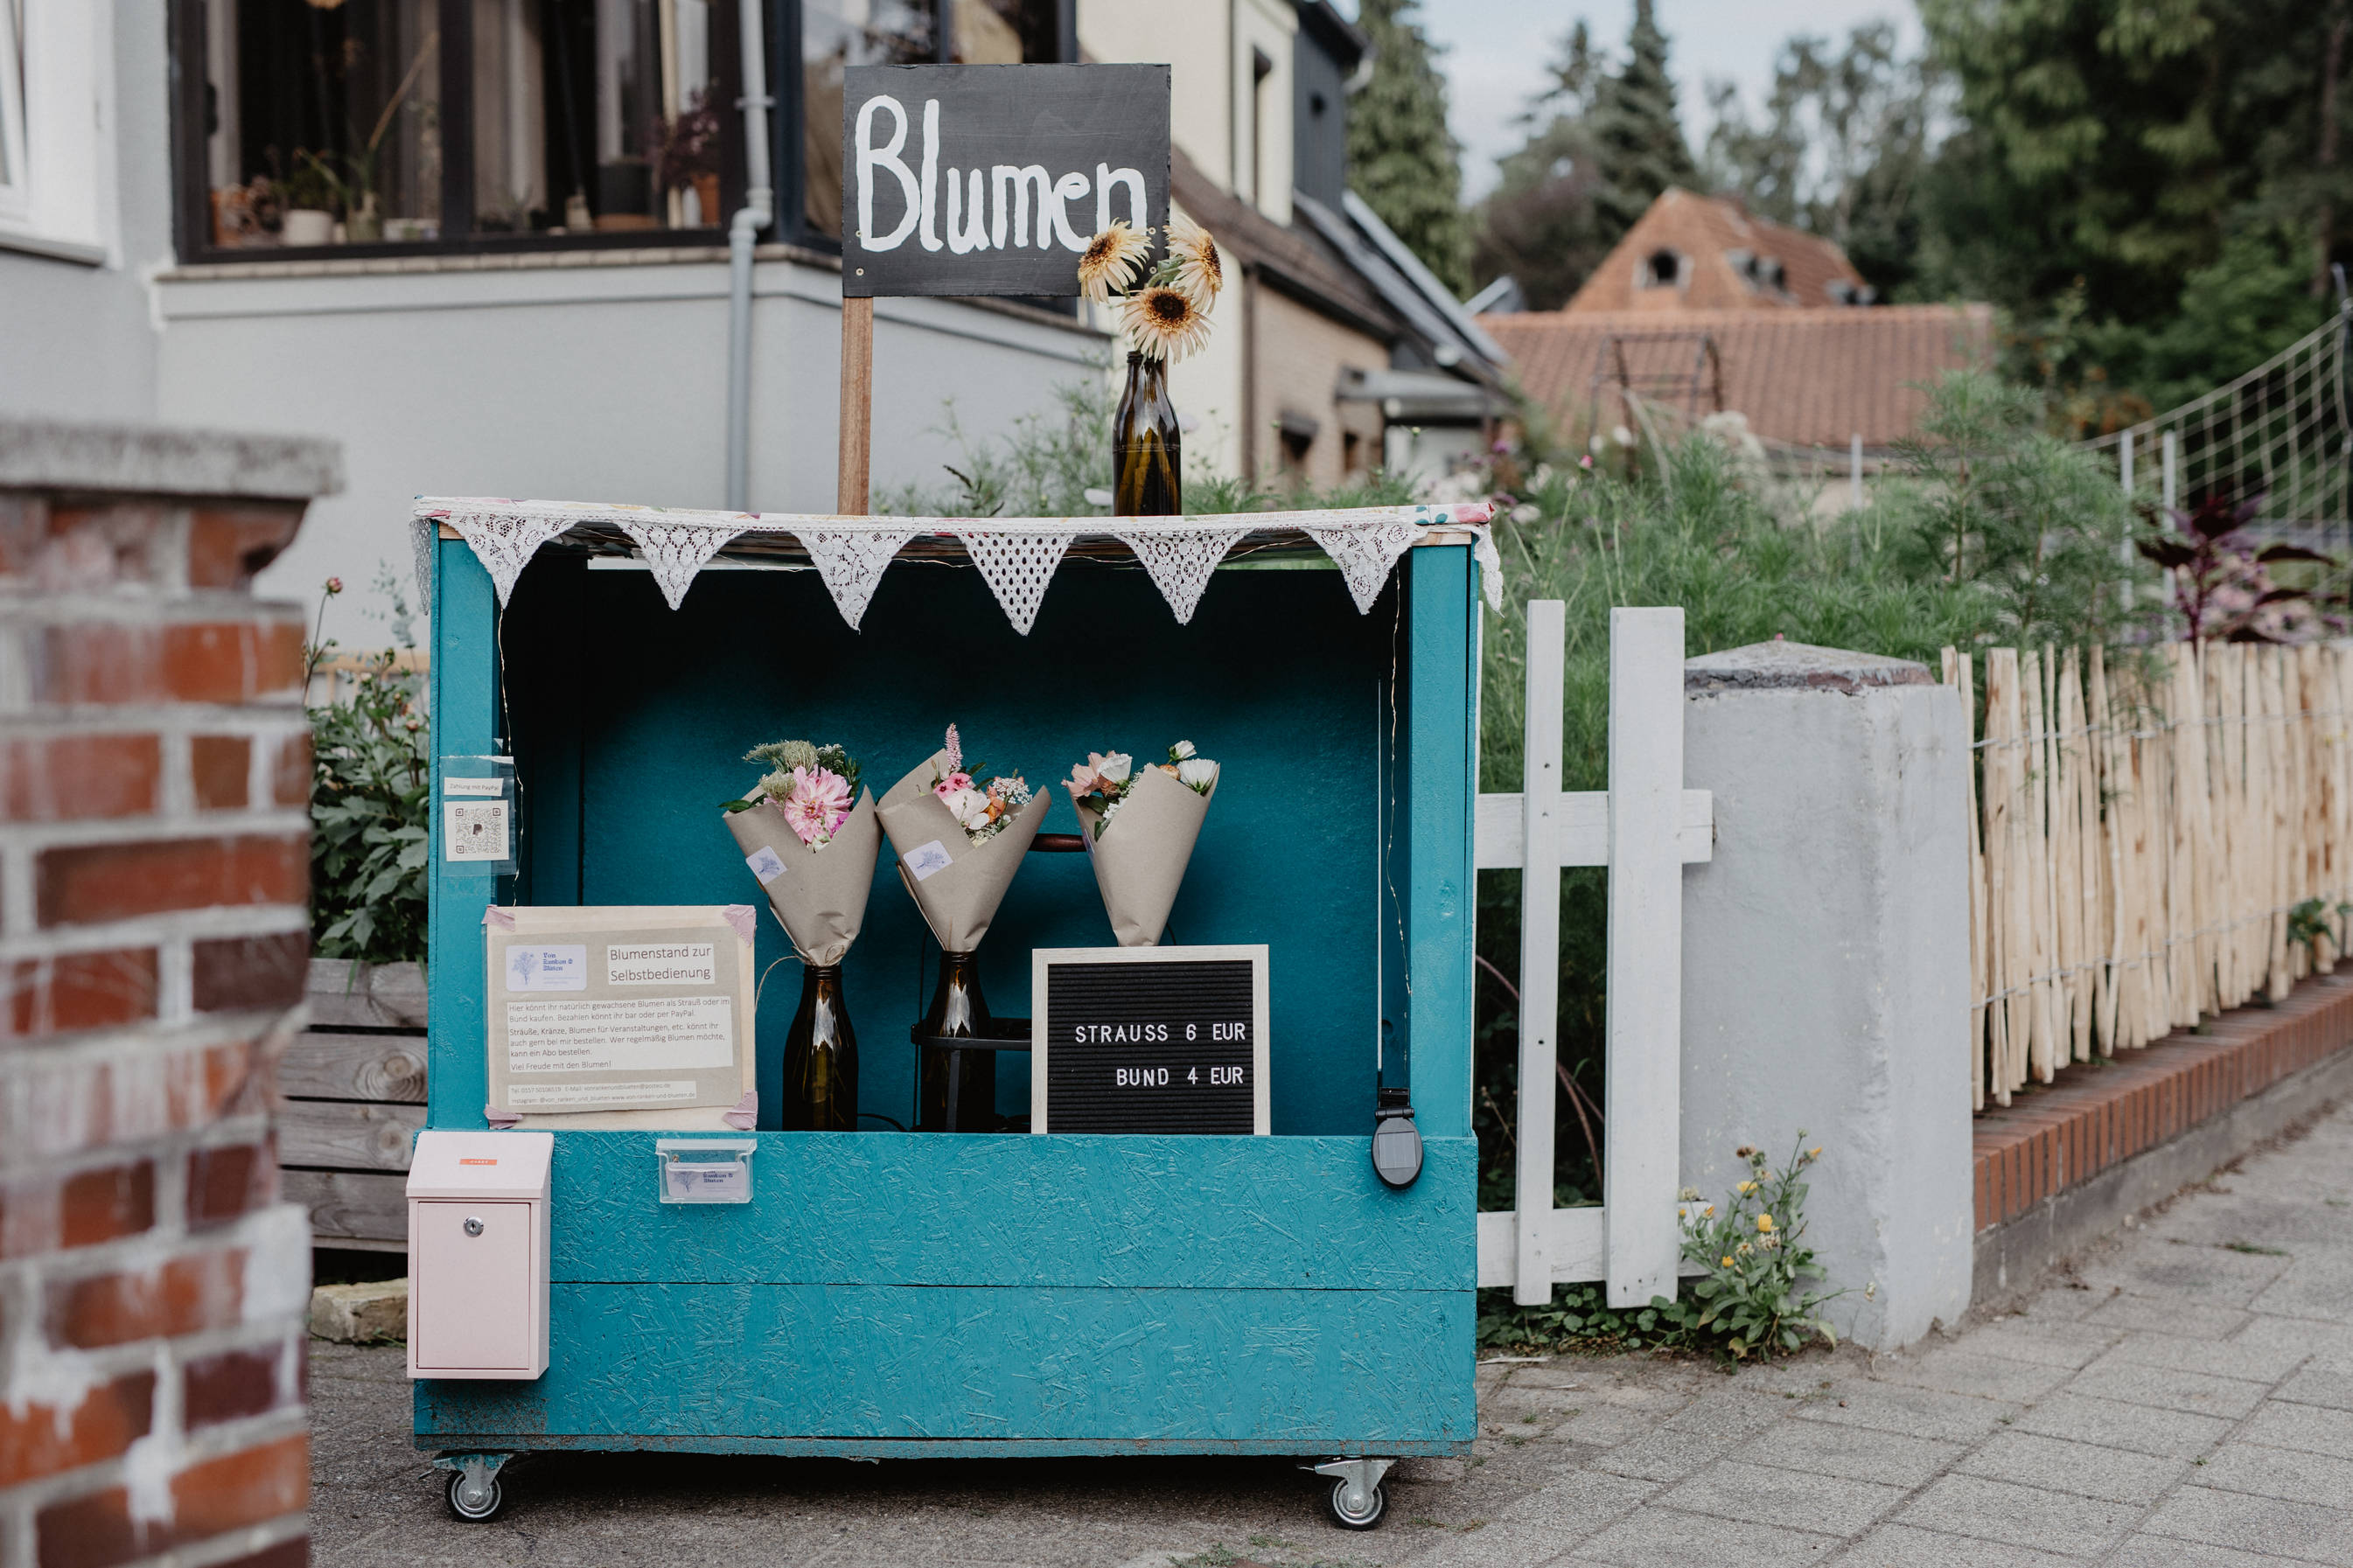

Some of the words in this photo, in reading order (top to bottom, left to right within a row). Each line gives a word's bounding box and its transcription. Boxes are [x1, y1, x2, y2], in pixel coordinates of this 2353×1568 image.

[855, 94, 1148, 254] Blumen
[610, 946, 689, 960] Blumenstand
[692, 947, 712, 958] zur
[611, 967, 711, 982] Selbstbedienung
[592, 1001, 636, 1010] gewachsene
[657, 1011, 669, 1020] per
[626, 1035, 667, 1044] regelmäßig
[1074, 1024, 1169, 1043] STRAUSS
[1185, 1024, 1197, 1042] 6
[1212, 1022, 1246, 1041] EUR
[582, 1060, 611, 1069] Blumen!
[1116, 1068, 1170, 1086] BUND
[1187, 1066, 1198, 1084] 4
[1211, 1066, 1244, 1084] EUR
